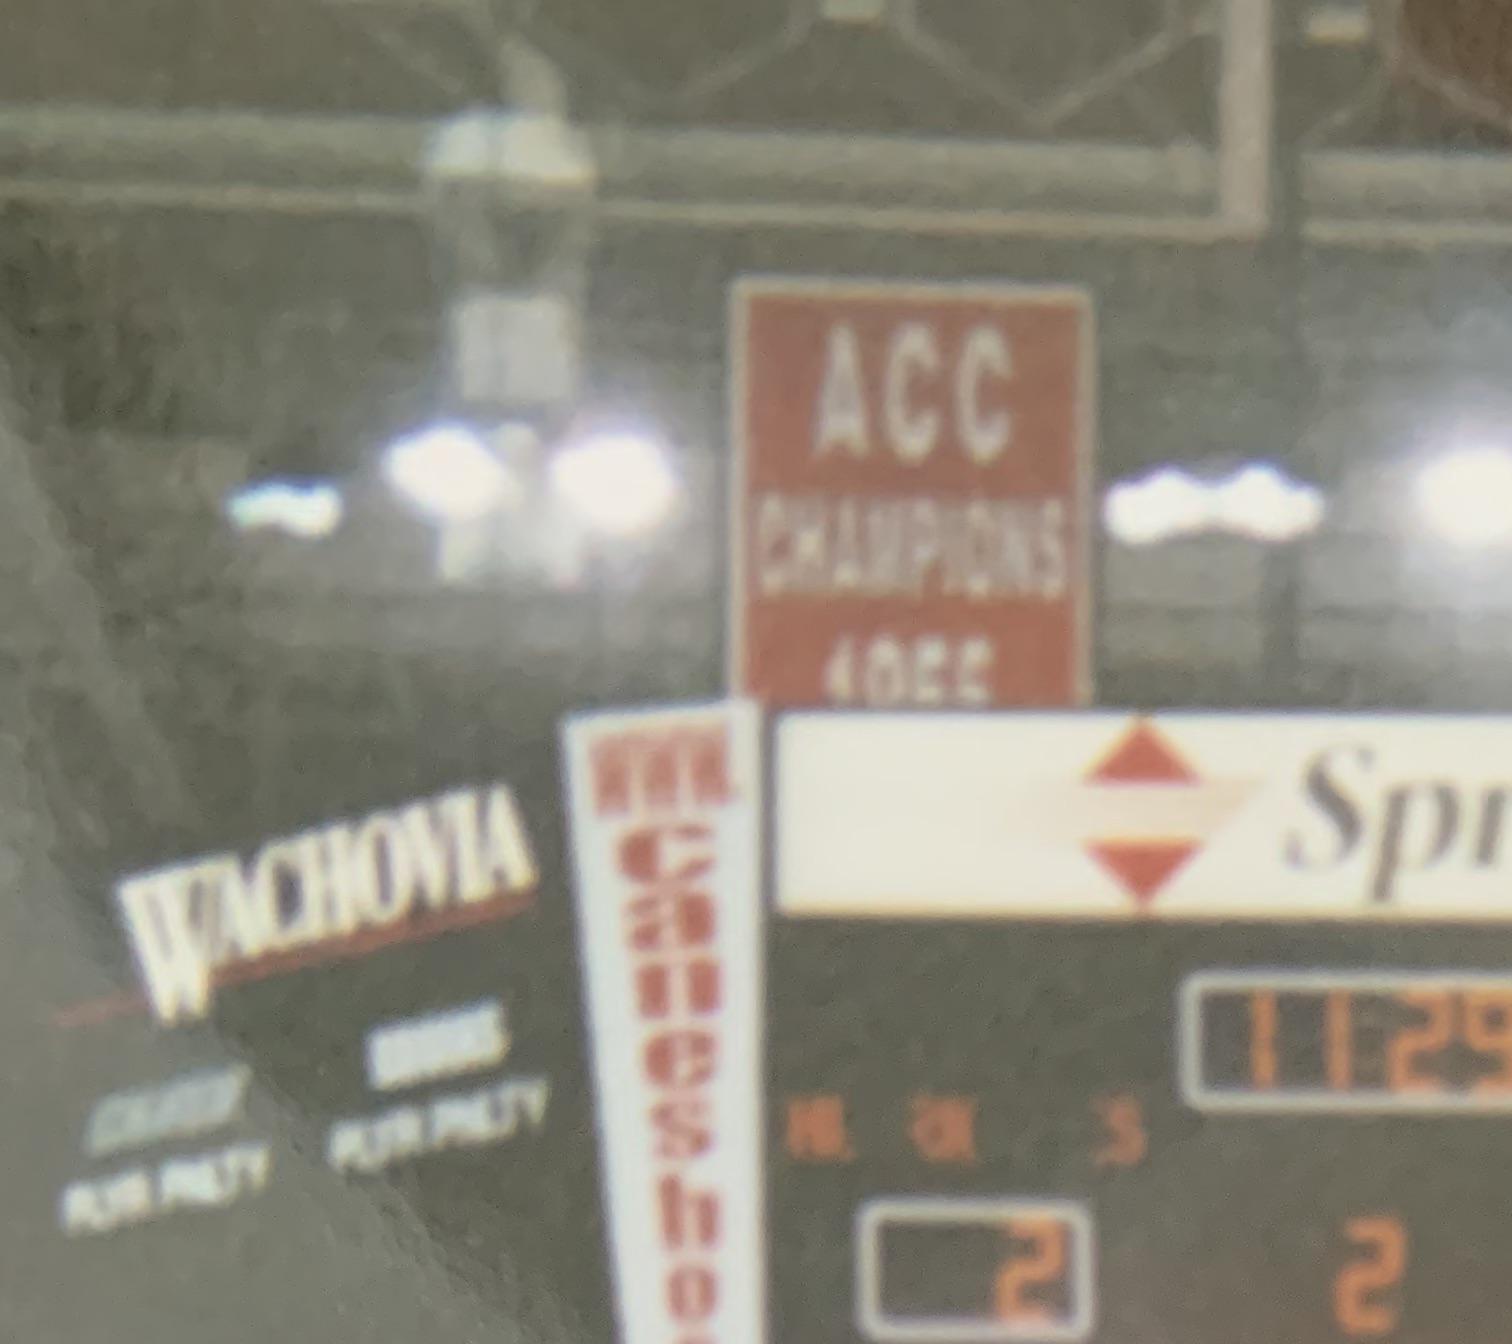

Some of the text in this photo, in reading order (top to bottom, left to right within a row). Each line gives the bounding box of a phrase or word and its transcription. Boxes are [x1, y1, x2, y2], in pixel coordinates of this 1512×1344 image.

[810, 318, 1018, 465] ACC
[757, 492, 1072, 600] CHAMPIONS
[115, 782, 541, 1030] WACHOVIA
[995, 1212, 1072, 1328] 2
[1330, 1215, 1408, 1335] 2
